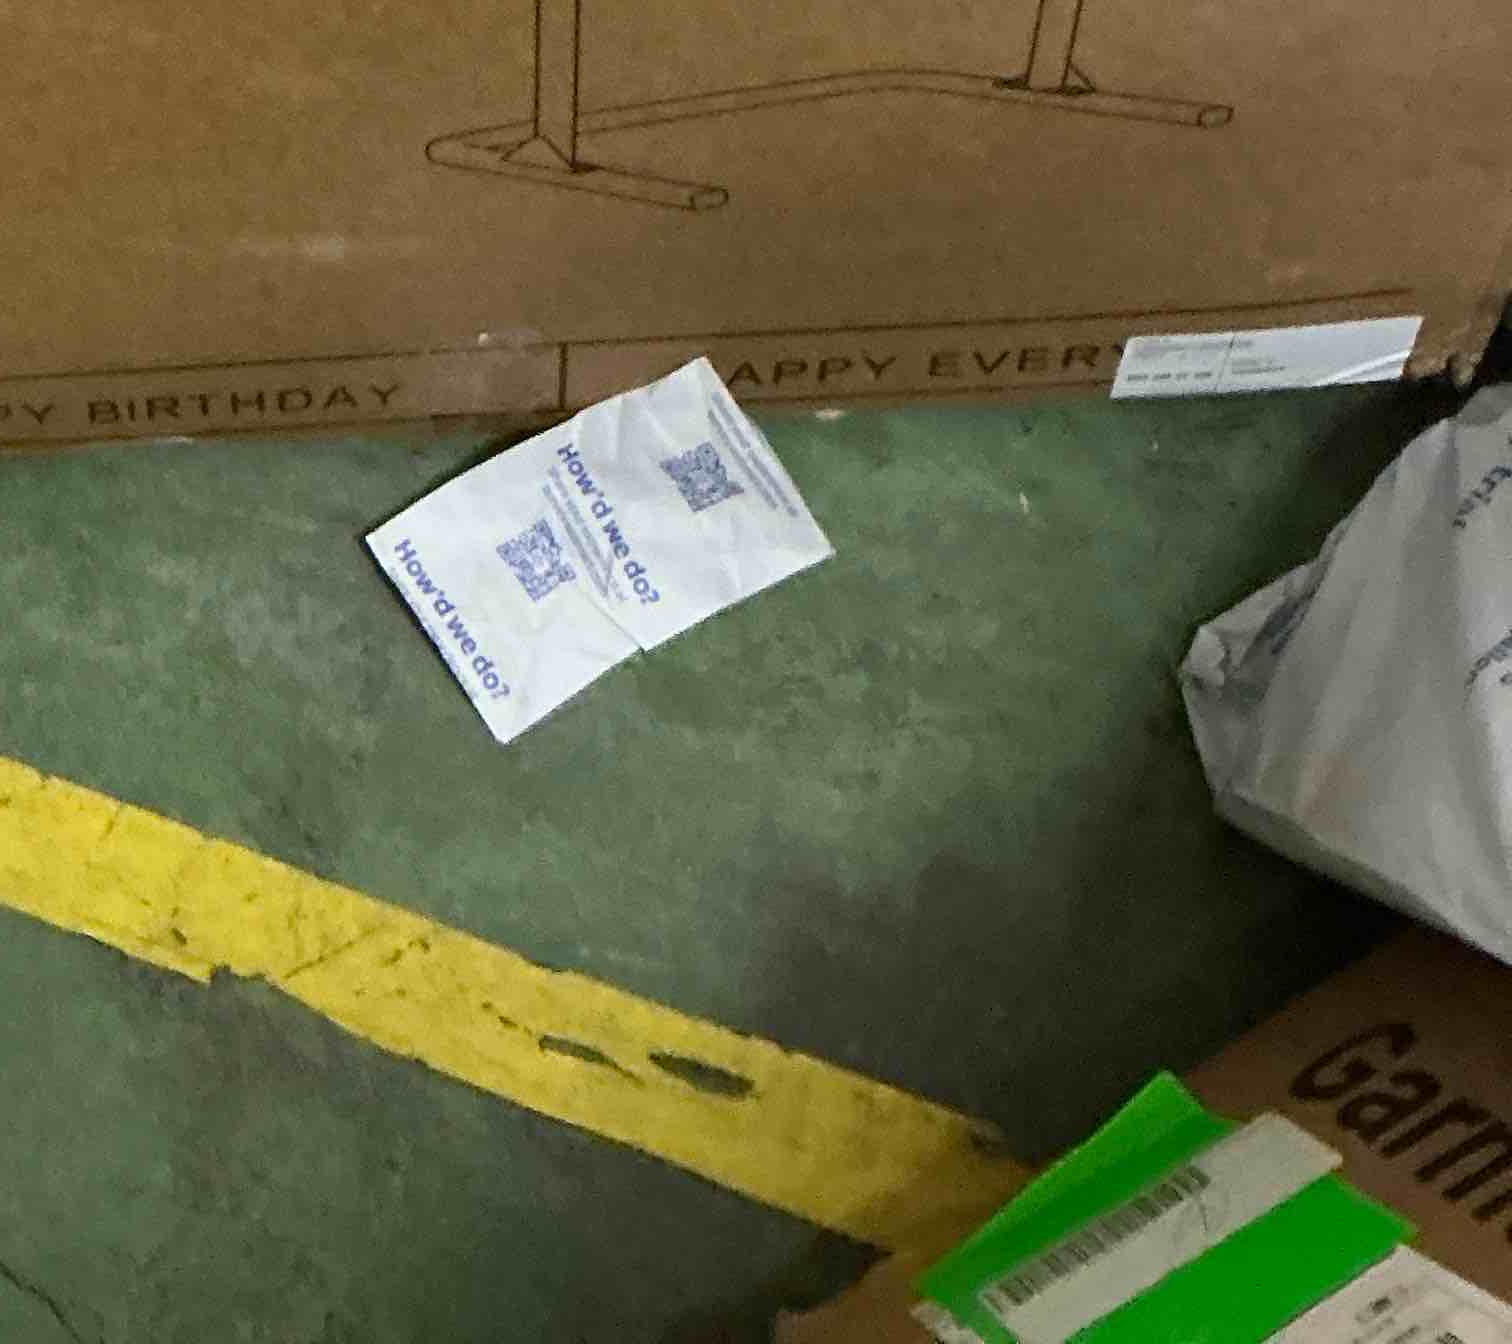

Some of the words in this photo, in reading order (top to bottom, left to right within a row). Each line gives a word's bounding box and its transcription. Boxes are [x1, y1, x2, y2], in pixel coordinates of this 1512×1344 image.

[88, 383, 401, 426] BIRTHDAY
[724, 353, 897, 390] APPY
[556, 442, 615, 522] How'd
[602, 516, 631, 561] we
[622, 558, 661, 605] do?
[393, 537, 456, 617] How'd
[447, 611, 478, 656] we
[471, 648, 512, 700] do?
